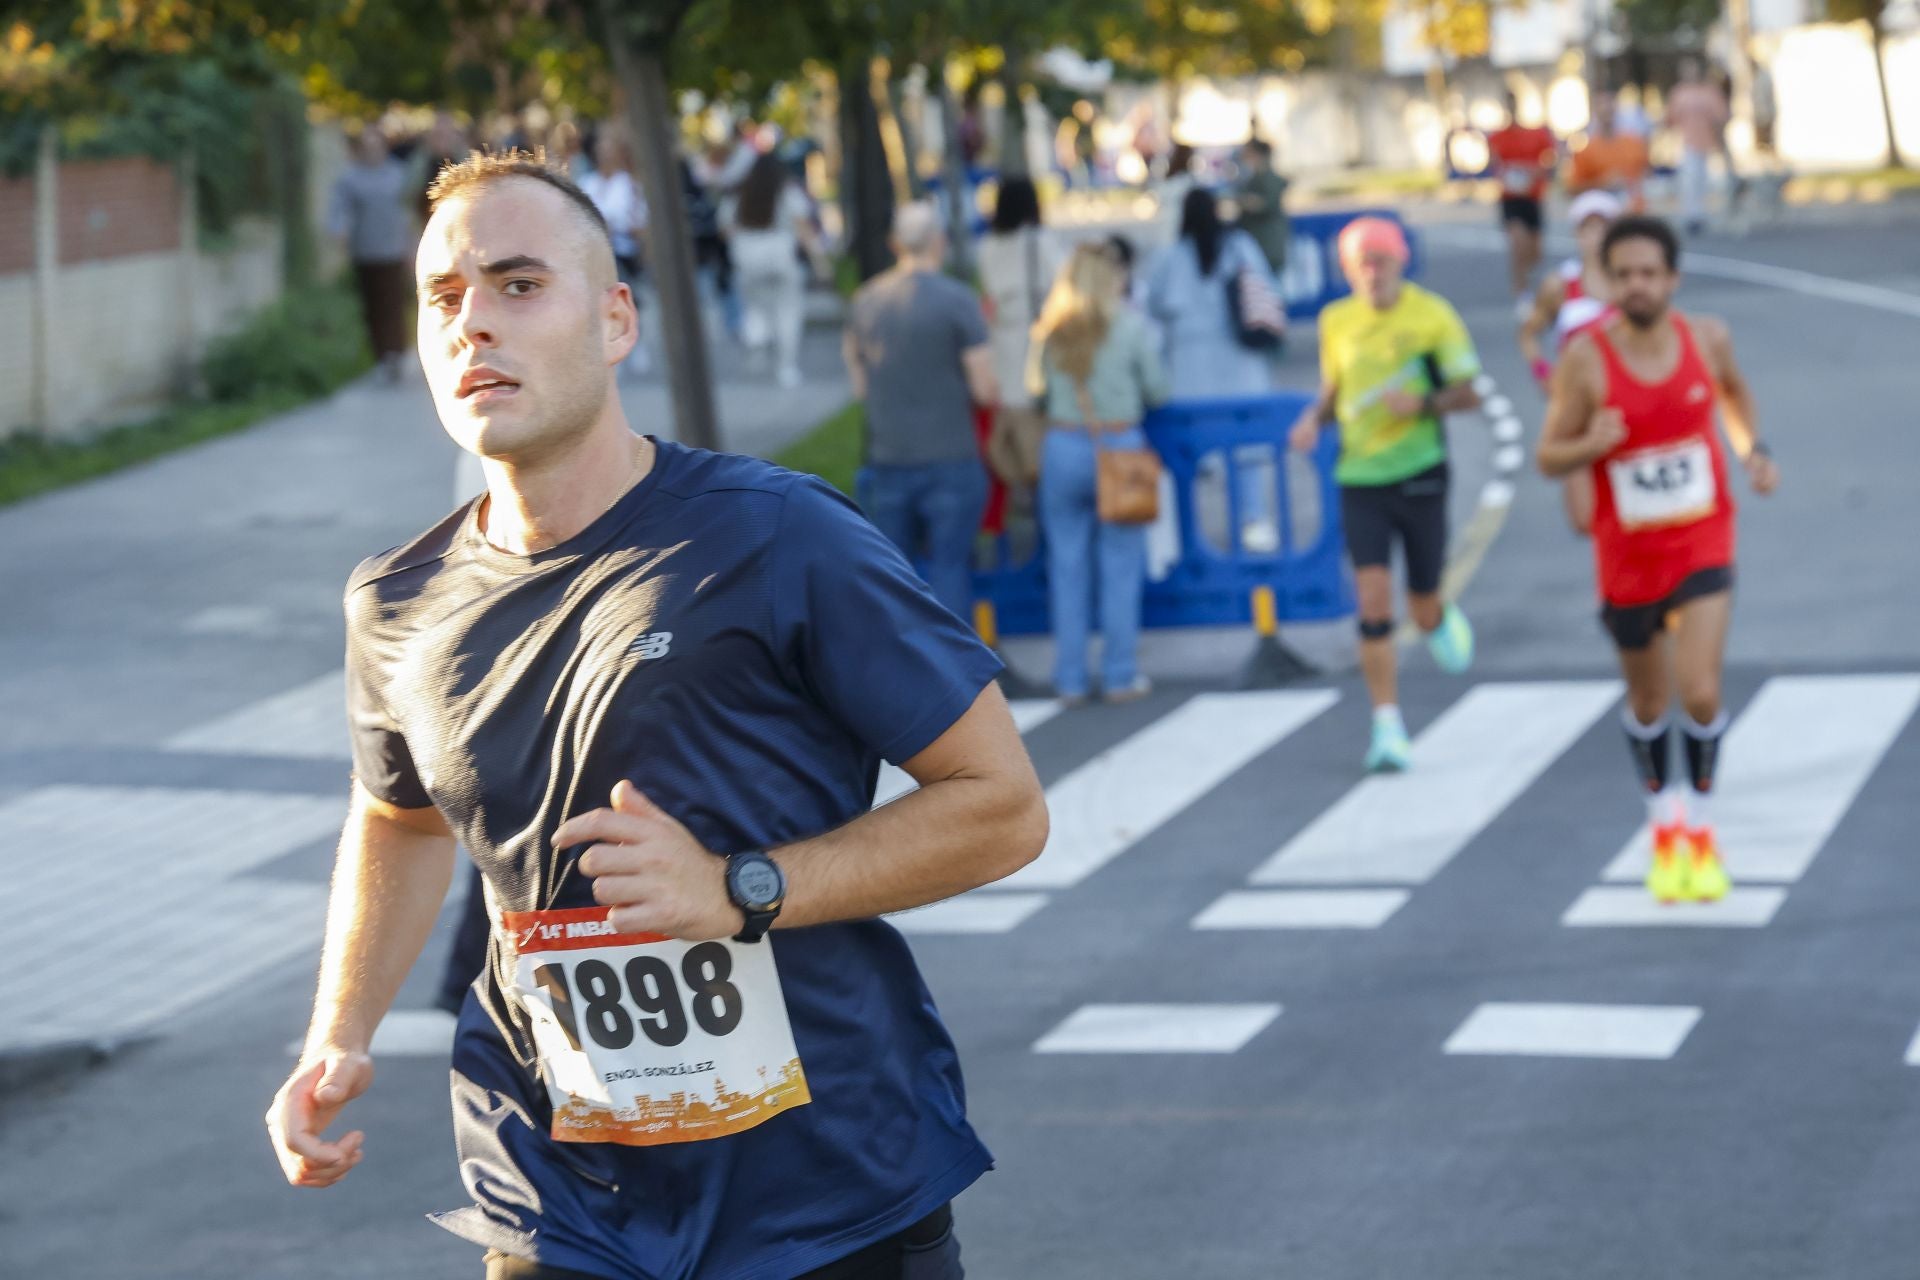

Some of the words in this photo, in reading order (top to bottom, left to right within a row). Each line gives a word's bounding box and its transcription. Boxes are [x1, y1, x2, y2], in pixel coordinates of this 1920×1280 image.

[534, 941, 742, 1051] 1898
[604, 1067, 642, 1083] ENOL
[642, 1060, 716, 1078] GONZÁLEZ
